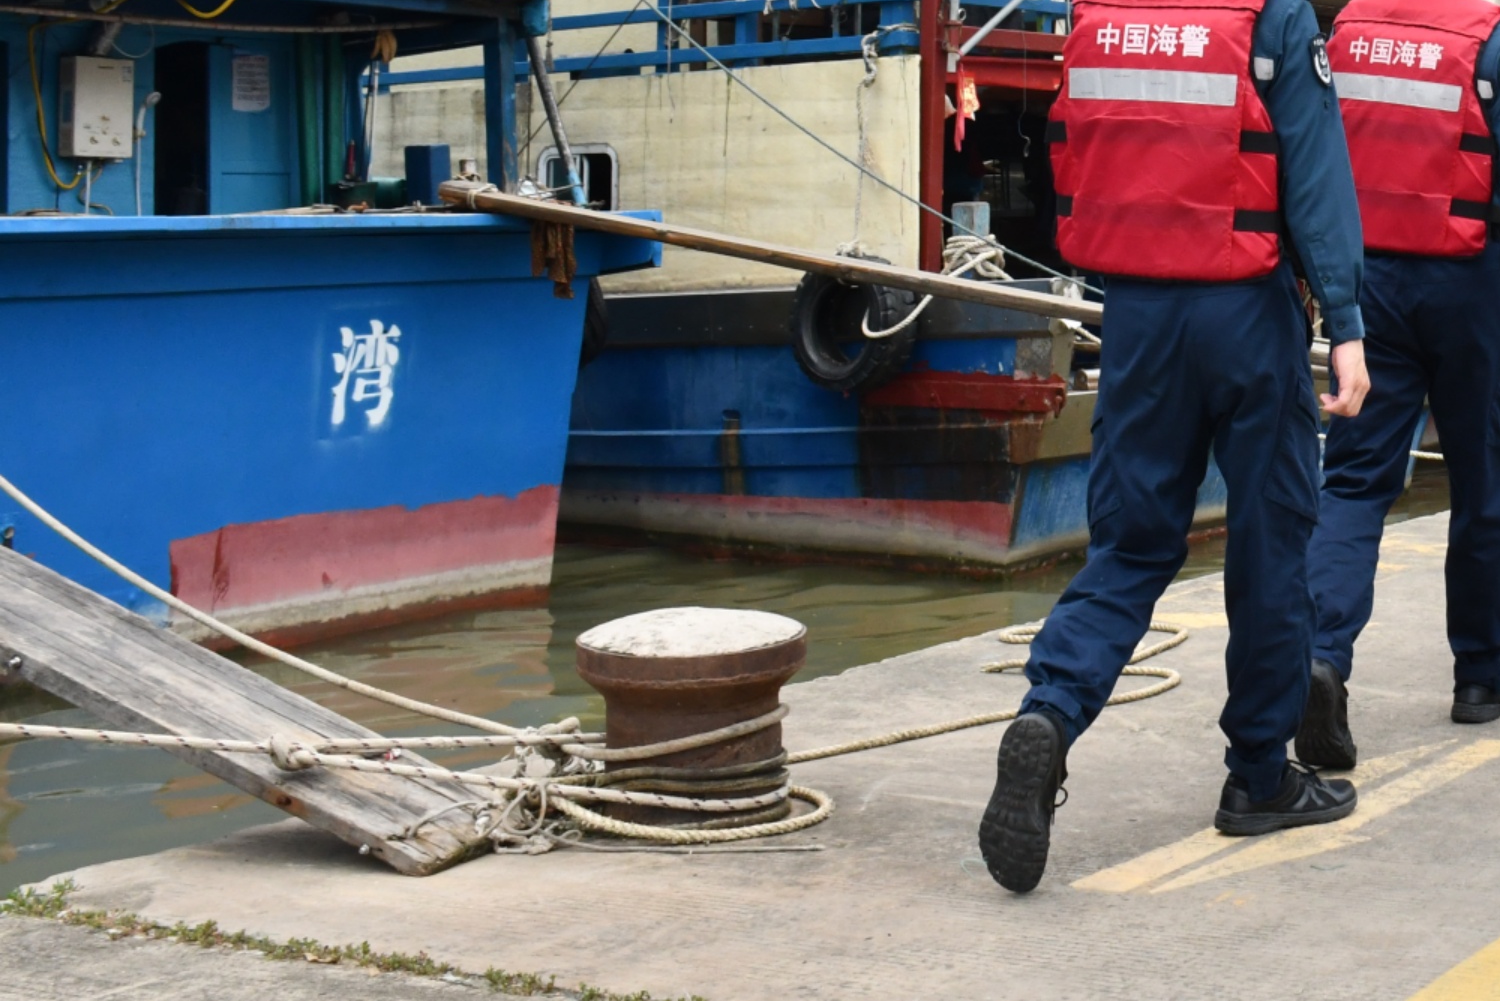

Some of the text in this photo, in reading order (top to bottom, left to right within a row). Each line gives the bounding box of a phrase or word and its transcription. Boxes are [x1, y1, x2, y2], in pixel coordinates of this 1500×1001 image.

[1096, 22, 1211, 58] 中国海警
[1349, 36, 1444, 70] 中国海警
[331, 319, 402, 426] 湾
